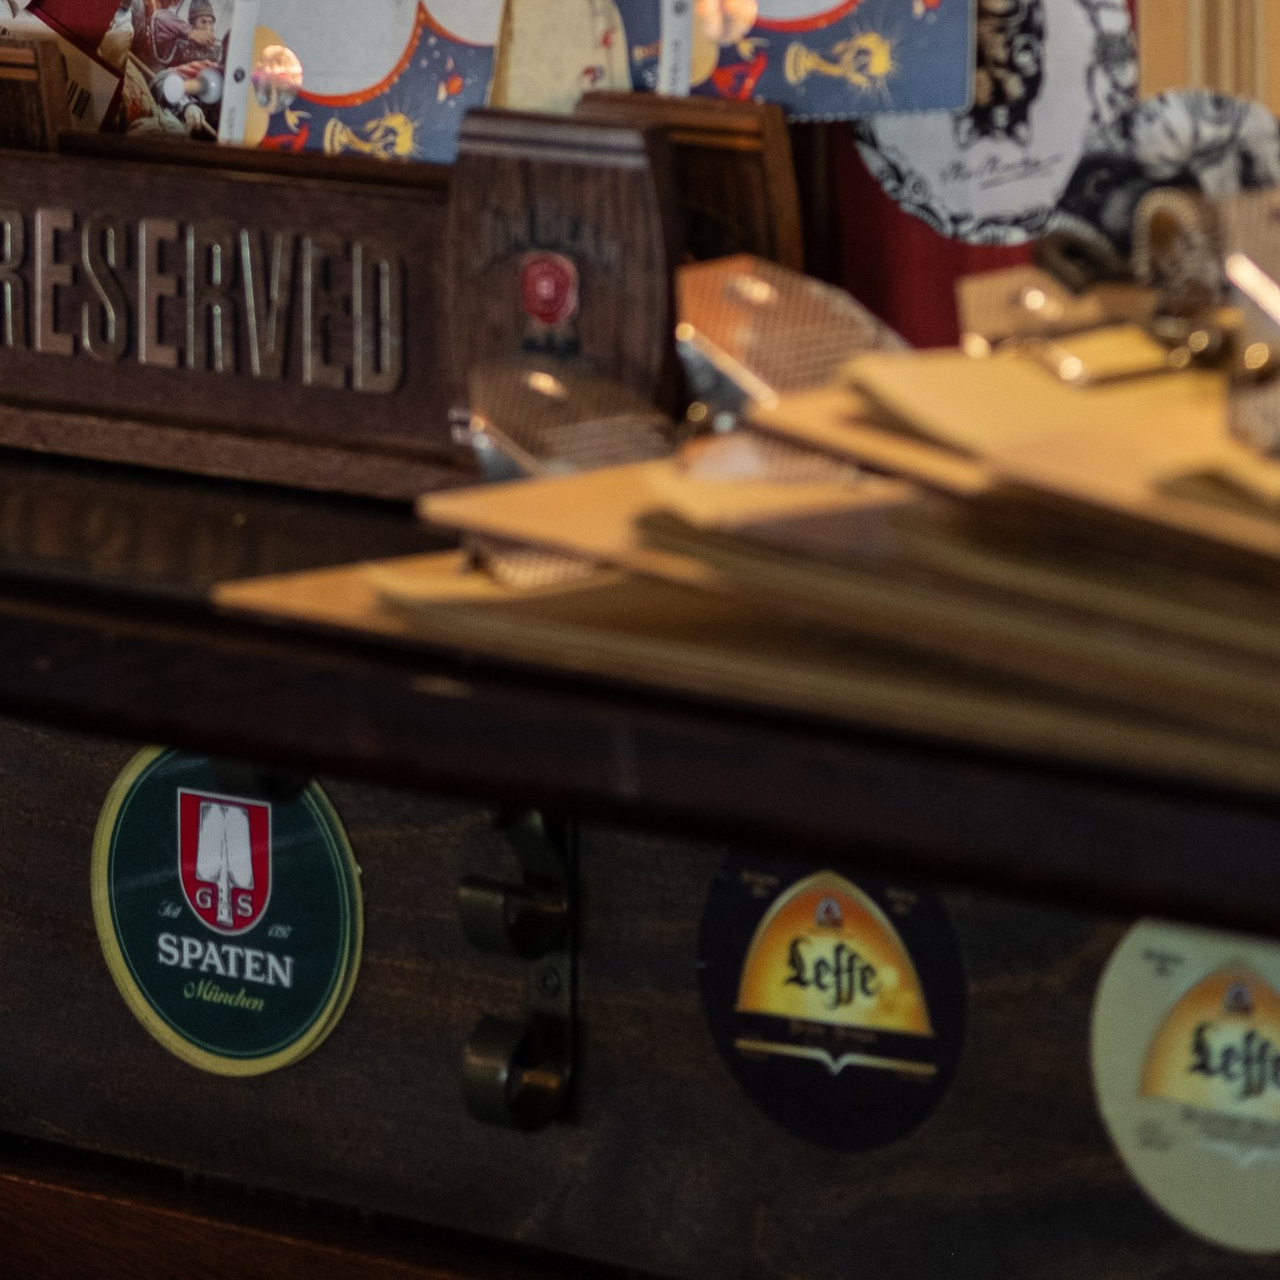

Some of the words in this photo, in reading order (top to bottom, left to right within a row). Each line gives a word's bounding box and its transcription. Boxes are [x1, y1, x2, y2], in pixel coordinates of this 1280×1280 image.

[156, 930, 295, 990] SPATEN
[784, 936, 880, 1010] Leffe
[181, 978, 267, 1015] München
